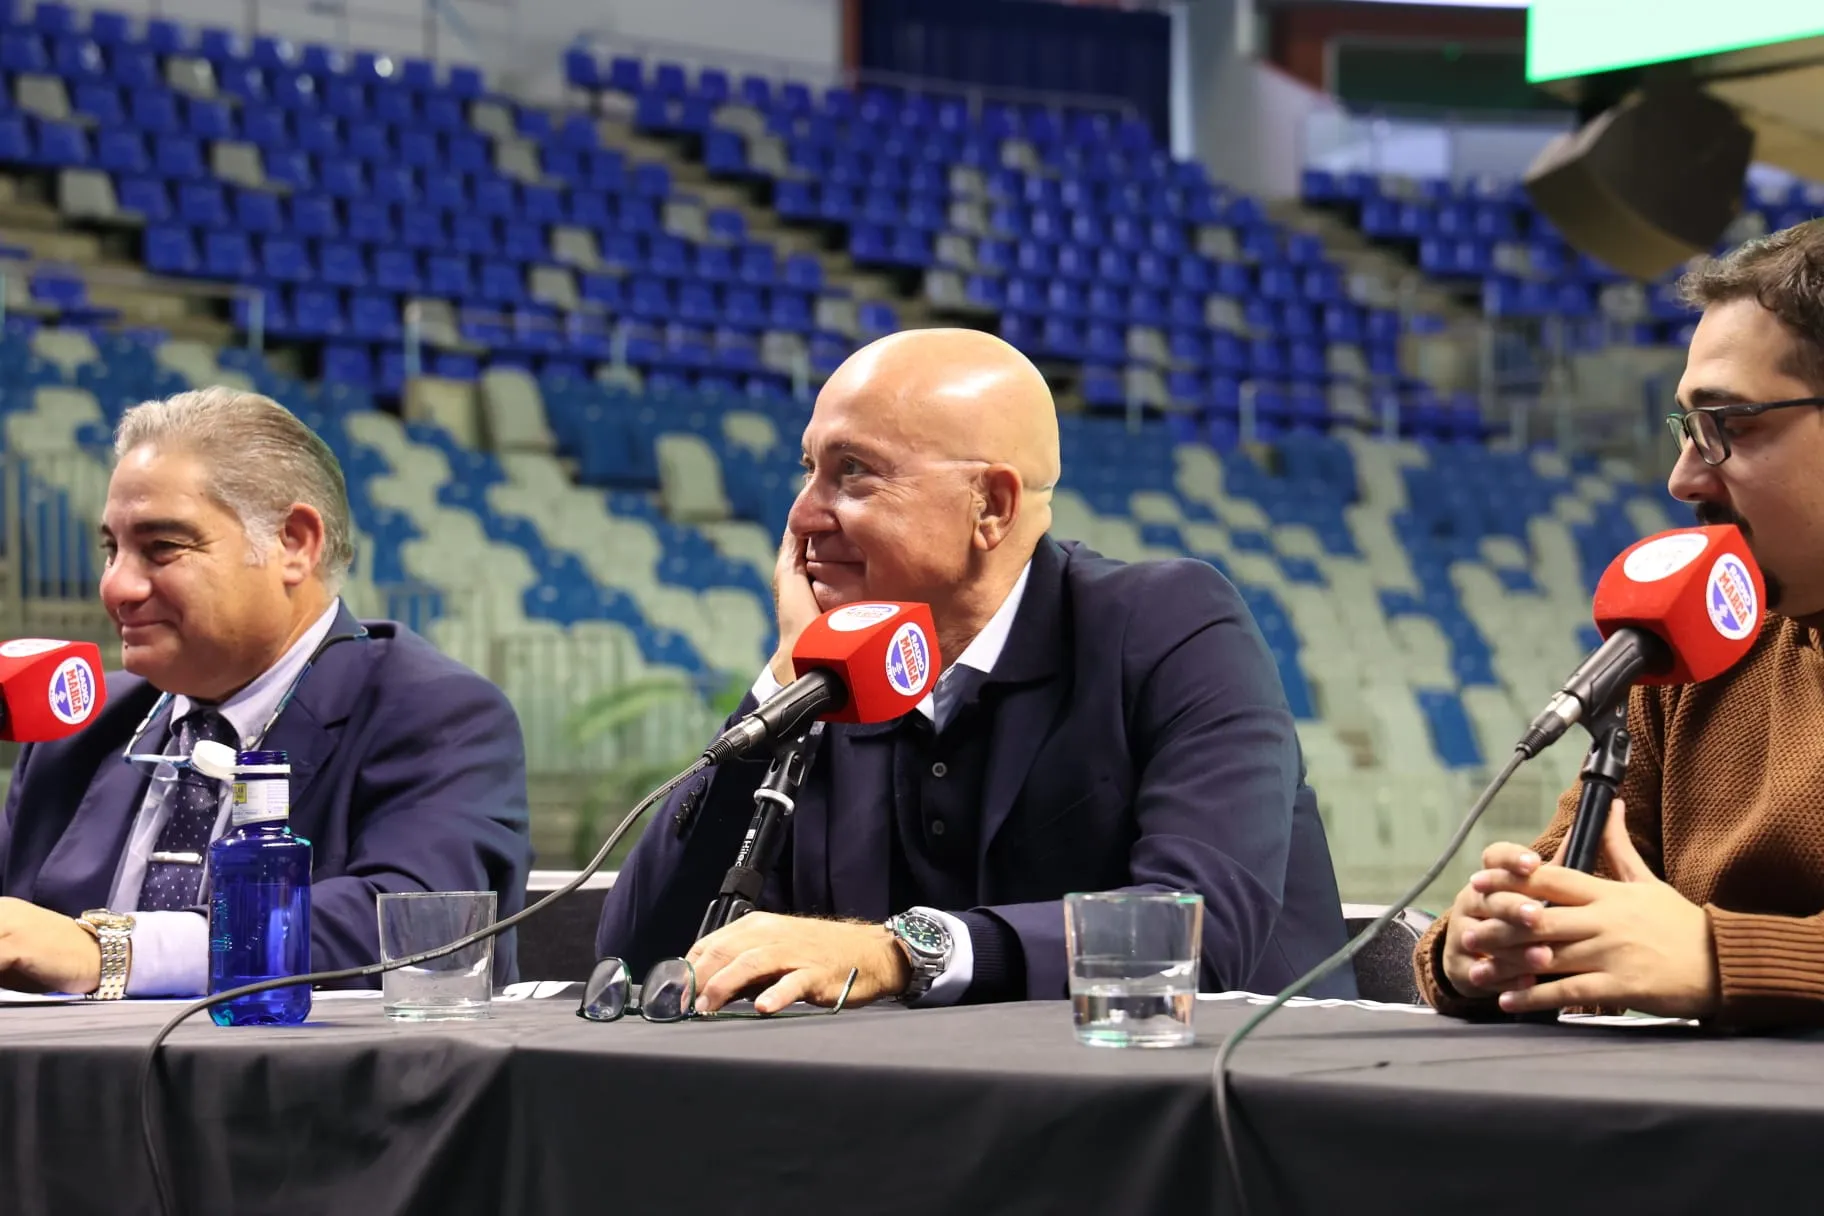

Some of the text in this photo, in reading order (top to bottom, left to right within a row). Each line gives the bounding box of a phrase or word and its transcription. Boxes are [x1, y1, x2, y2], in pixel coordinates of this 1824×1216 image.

[1718, 571, 1748, 626] MARCA
[1729, 565, 1752, 607] RADIO
[900, 635, 919, 687] MARCA
[911, 633, 925, 671] RADIO
[66, 669, 82, 716] MARCA
[78, 668, 90, 705] RADIO
